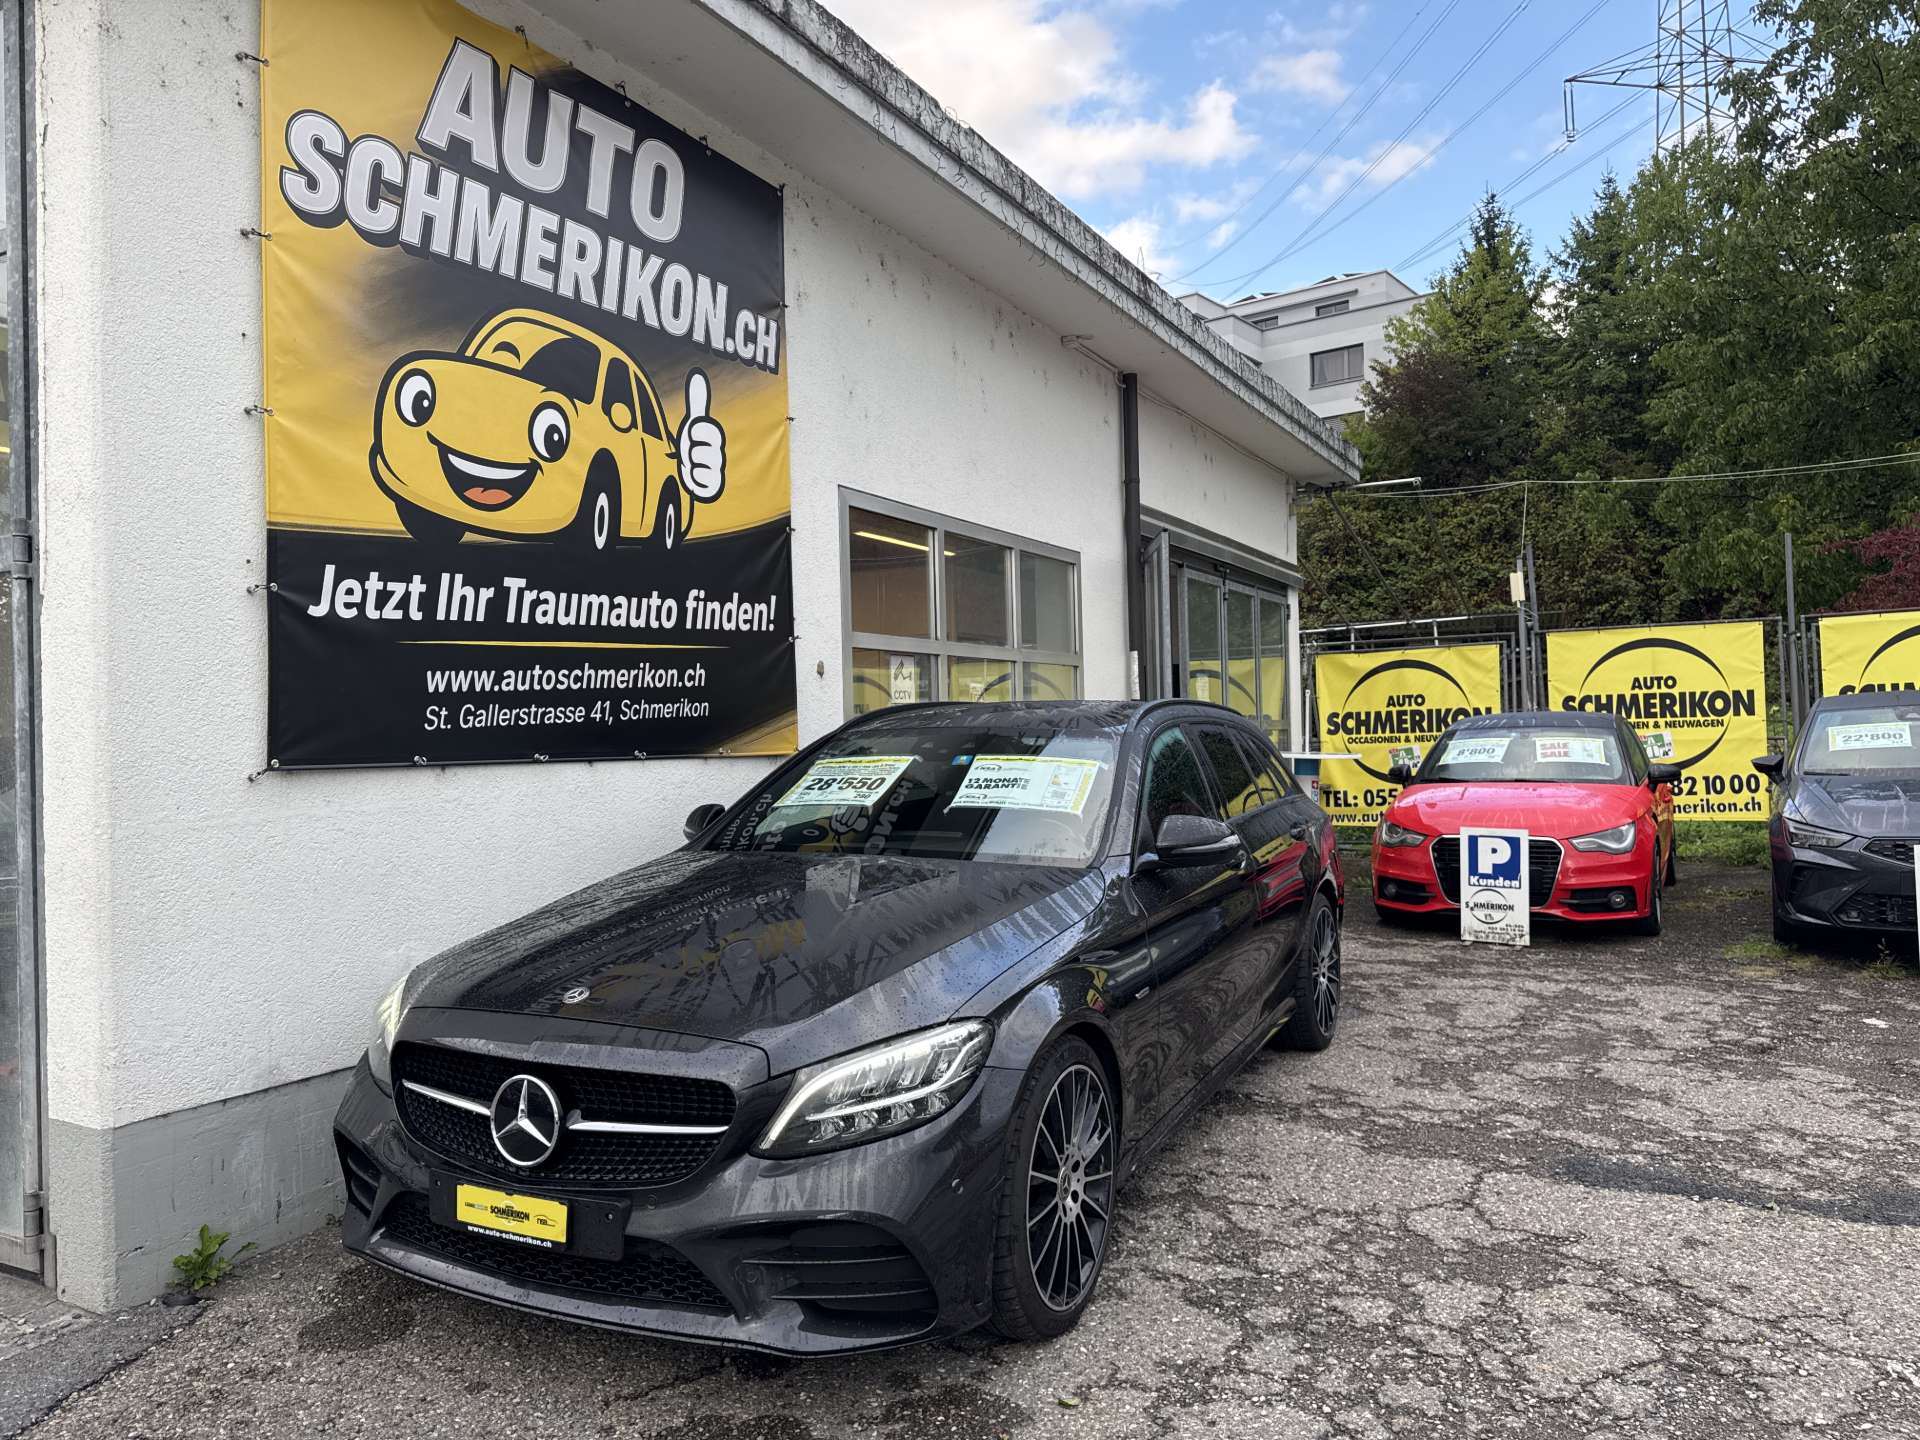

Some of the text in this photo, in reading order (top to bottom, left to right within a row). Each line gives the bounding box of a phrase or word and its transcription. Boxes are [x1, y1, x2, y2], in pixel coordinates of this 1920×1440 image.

[417, 37, 686, 243] AUTO
[280, 110, 780, 370] SCHMERIKON.CH
[307, 564, 776, 631] Jetzt Ihr Traumauto finden!
[426, 662, 706, 694] www.autoschmerikon.ch
[1631, 675, 1677, 690] AUTO
[894, 690, 912, 700] CCTV
[1386, 694, 1426, 708] AUTO
[1562, 689, 1756, 720] SCHMERIKON
[424, 699, 710, 731] St. Gallerstrasse 41, Schmerikon
[1653, 720, 1661, 729] &
[1665, 719, 1725, 729] NEUWAGEN
[1347, 736, 1401, 745] OCCASIONEN
[1842, 732, 1904, 744] 22'800
[803, 777, 888, 791] 28'550
[981, 777, 1031, 785] MONATE
[1322, 789, 1359, 808] TEL:
[1477, 837, 1512, 874] P
[1469, 875, 1521, 889] Kunden
[1464, 901, 1515, 912] SHMERIKON
[490, 1205, 530, 1222] SCHMERIKON
[467, 1225, 552, 1249] www.auto-schmerikon.ch
